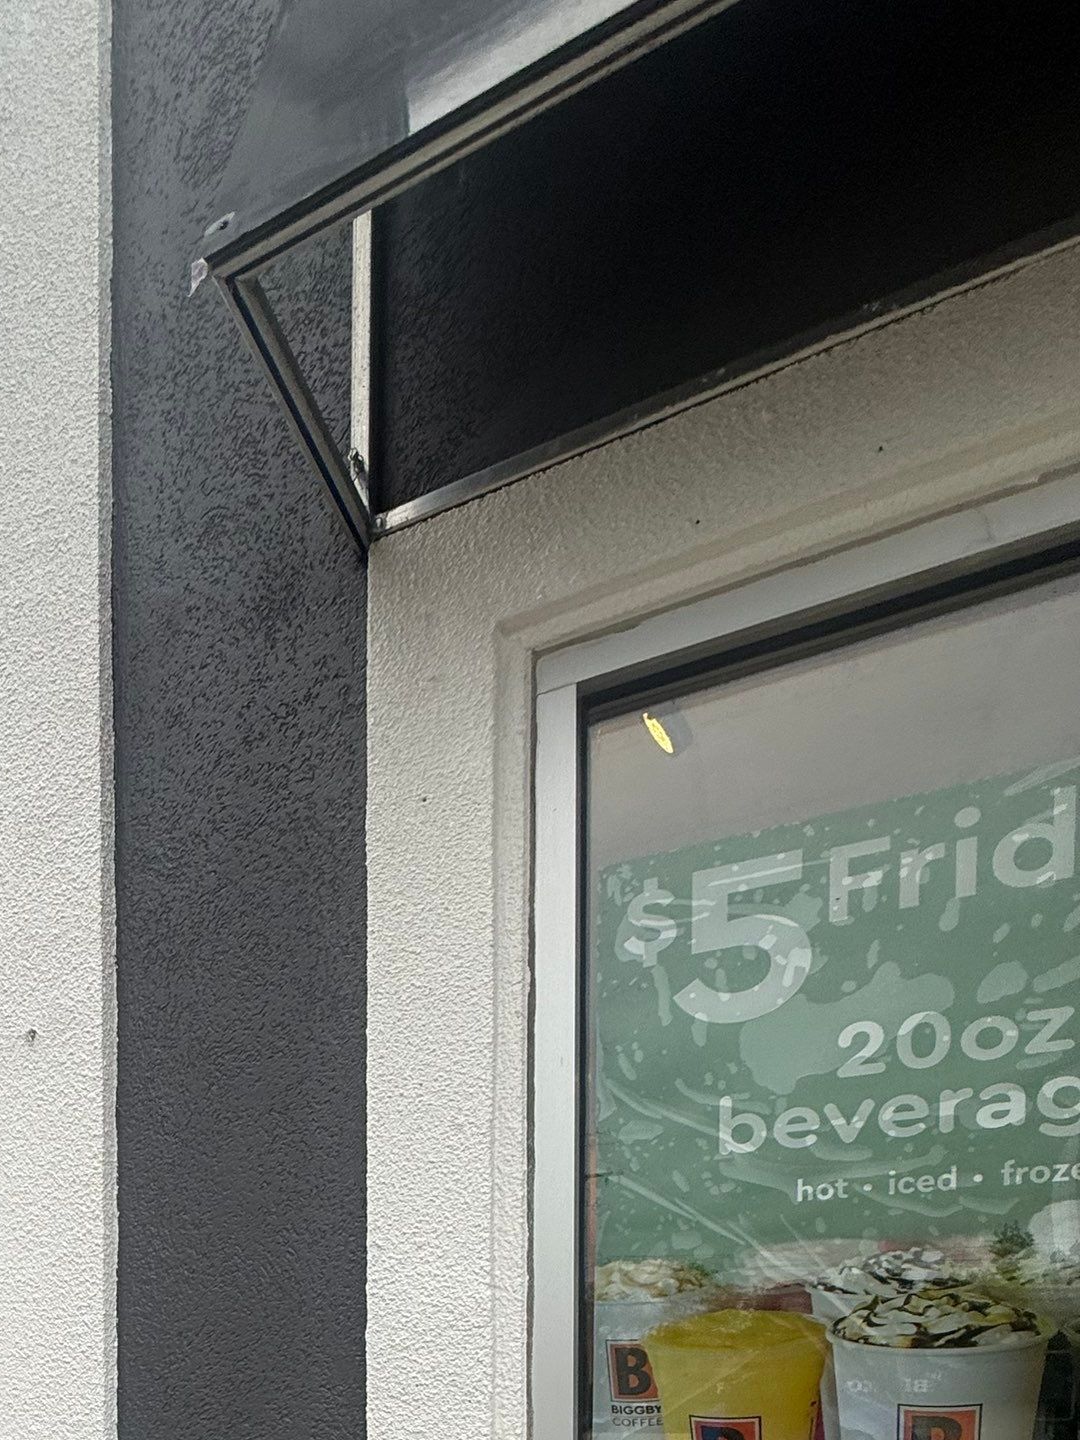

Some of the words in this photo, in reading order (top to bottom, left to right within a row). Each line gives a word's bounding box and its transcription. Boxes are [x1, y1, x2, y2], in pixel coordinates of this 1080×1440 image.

[622, 848, 813, 1024] $5
[828, 784, 1078, 923] Frid
[837, 1006, 1076, 1078] 20oz
[719, 1076, 1080, 1155] beverag
[796, 1178, 849, 1202] hot
[888, 1165, 958, 1196] iced
[614, 1346, 652, 1396] B
[611, 1404, 662, 1415] BIGGBY
[612, 1417, 664, 1427] COFFEE
